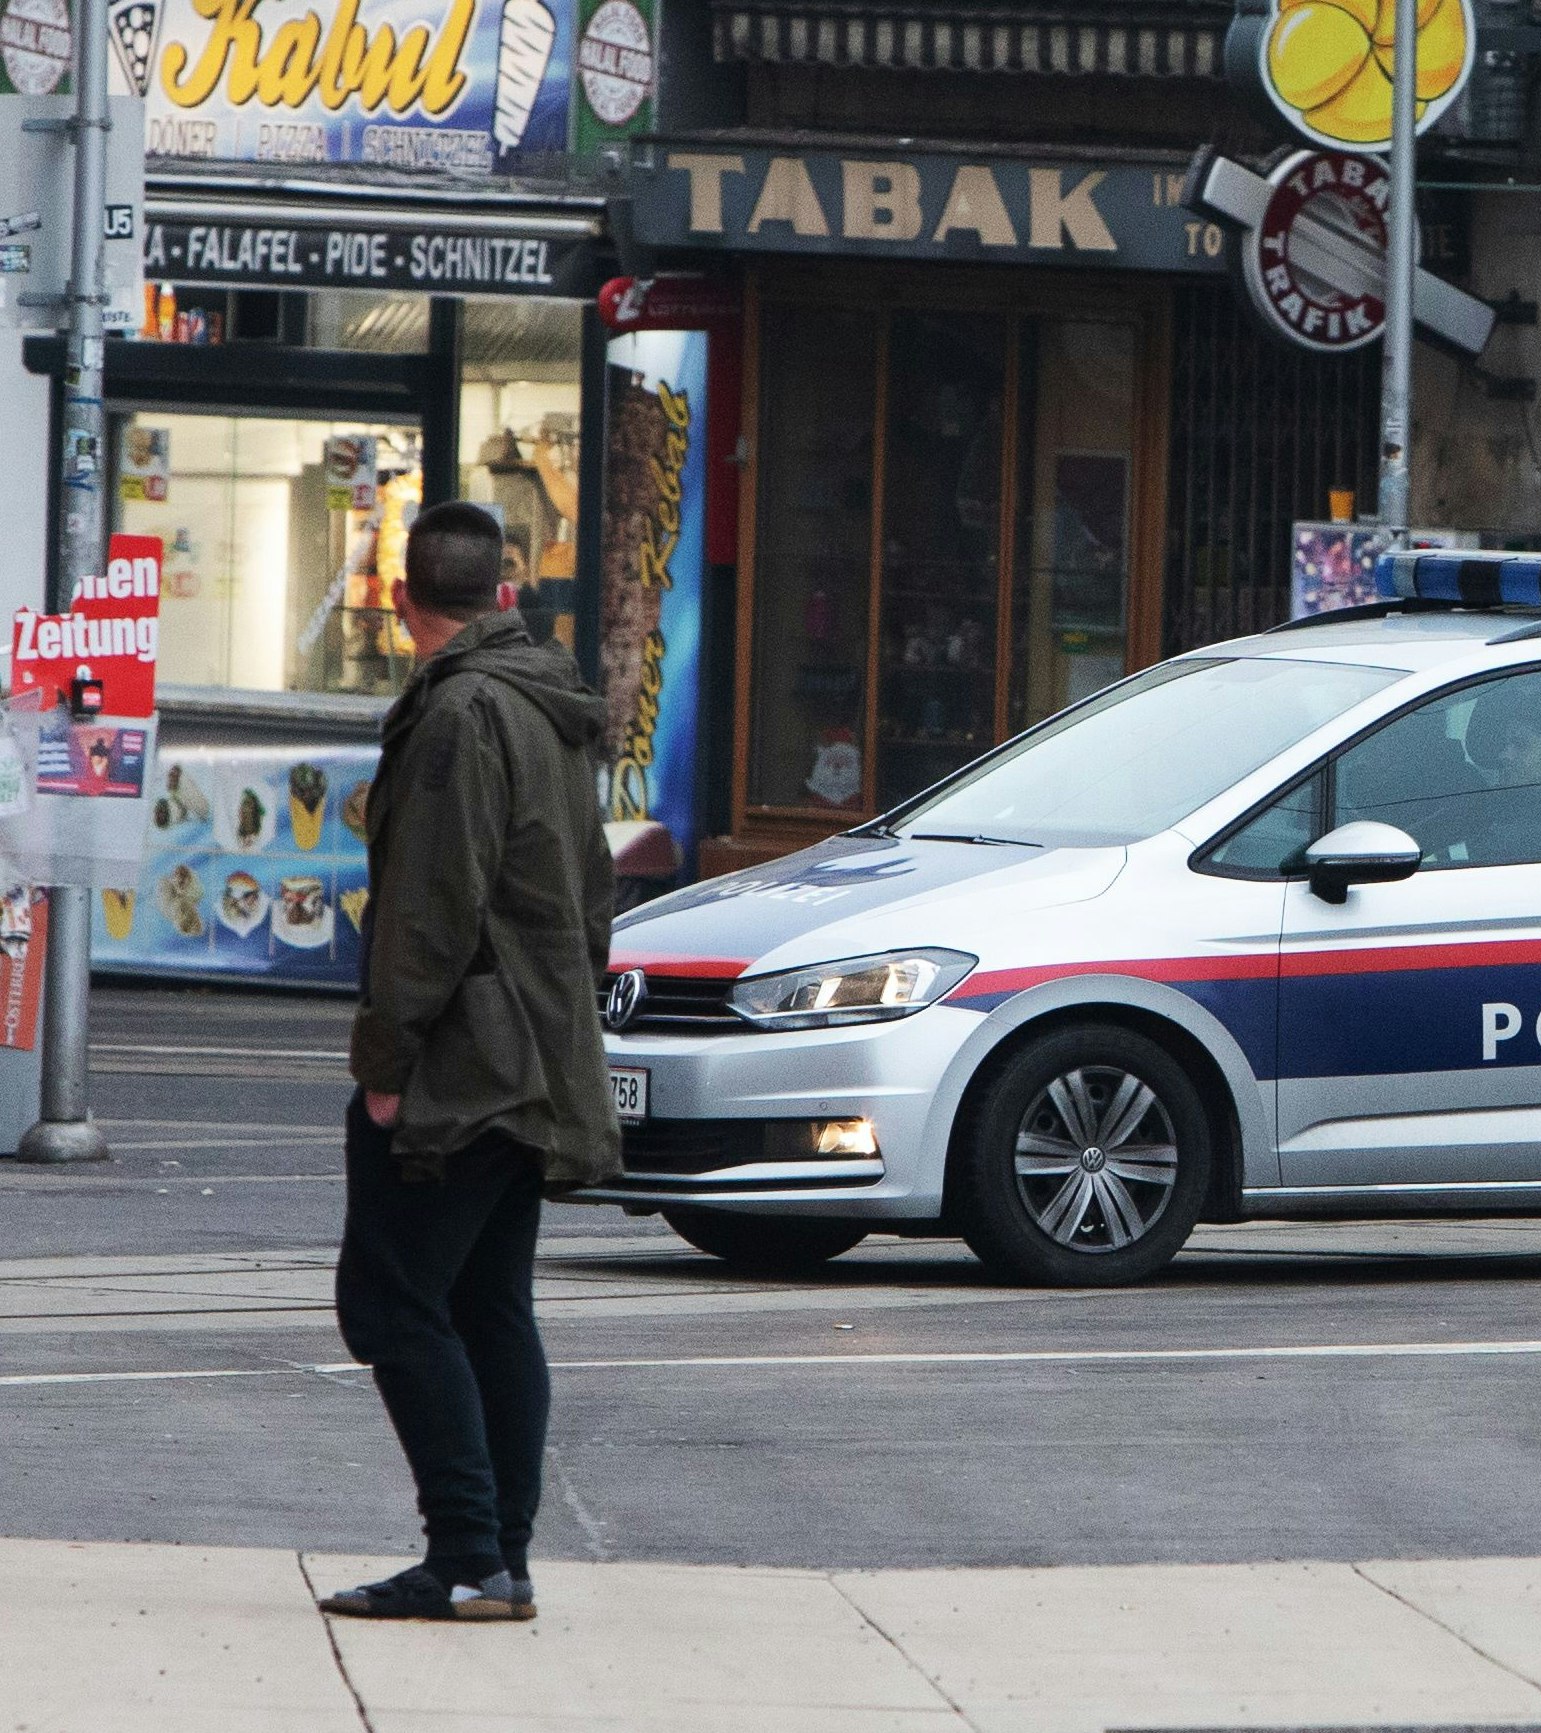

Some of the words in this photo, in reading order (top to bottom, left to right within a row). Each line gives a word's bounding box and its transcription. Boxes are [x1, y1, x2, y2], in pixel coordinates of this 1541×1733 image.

[161, 0, 468, 113] Kabul
[258, 123, 325, 159] PIZZA
[105, 207, 132, 236] U5
[667, 152, 1119, 252] TABAK
[1288, 157, 1393, 227] TABA
[187, 225, 303, 274] FALAFEL
[326, 230, 389, 278] PIDE
[408, 234, 553, 284] SCHNITZEL
[1262, 229, 1376, 341] TRAFIK
[639, 379, 692, 591] Kebab
[15, 610, 160, 663] Zeitung
[611, 629, 665, 822] Döner
